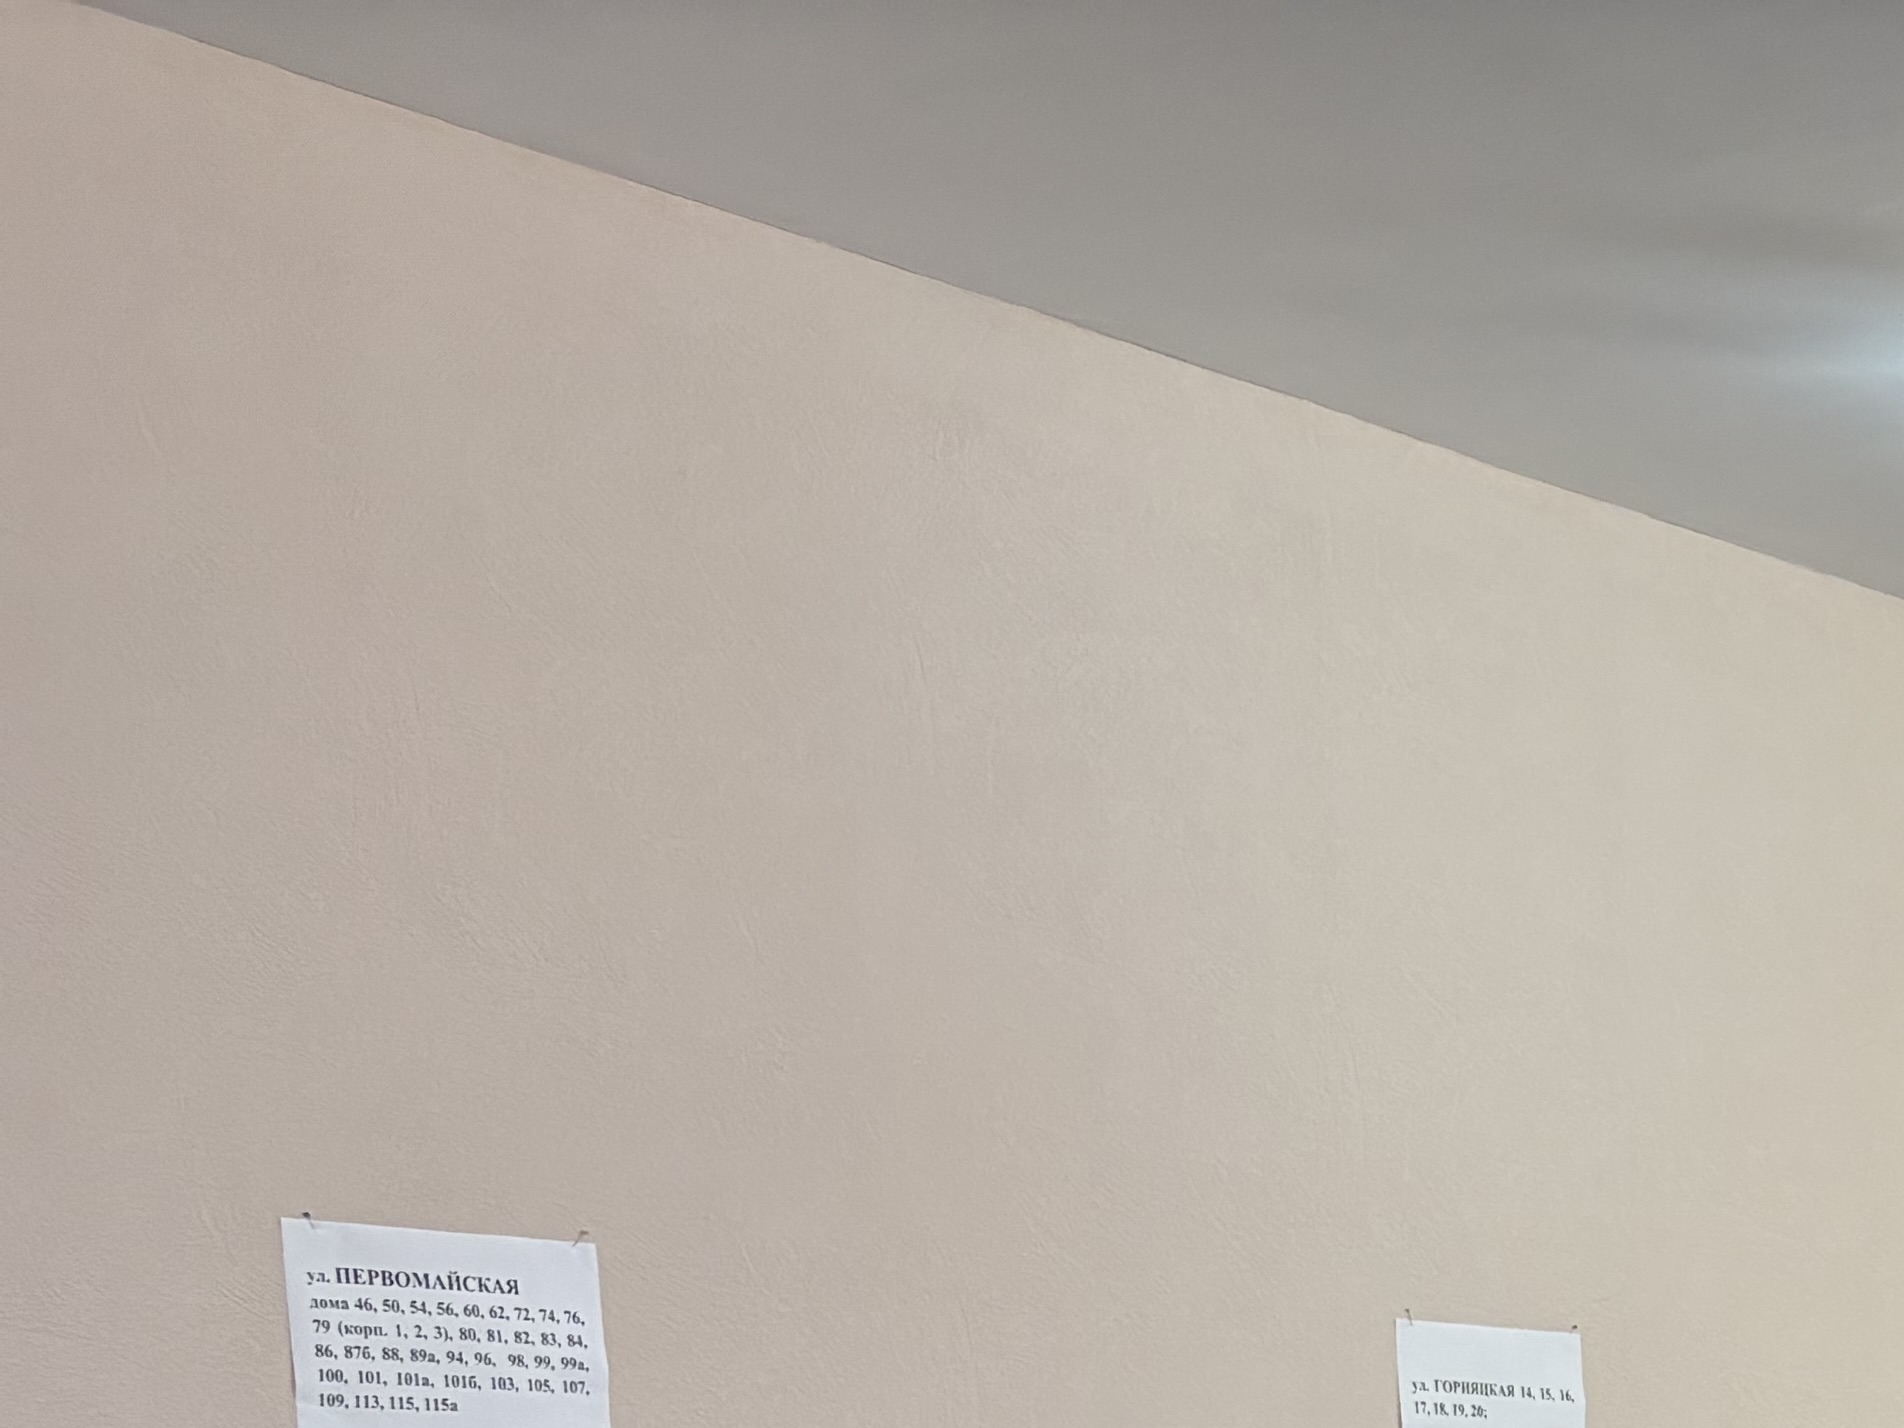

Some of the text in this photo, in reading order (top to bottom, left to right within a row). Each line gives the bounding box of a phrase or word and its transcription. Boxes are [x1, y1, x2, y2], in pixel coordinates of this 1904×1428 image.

[306, 1267, 519, 1295] ул. ПЕРВОМАЙСКАЯ
[310, 1298, 349, 1309] дома
[354, 1298, 377, 1313] 46,
[382, 1299, 405, 1315] 50,
[437, 1302, 458, 1317] 56,
[514, 1308, 535, 1322] 72,
[539, 1309, 560, 1324] 74,
[564, 1311, 585, 1326] 76,
[312, 1319, 330, 1333] 79
[338, 1321, 388, 1339] (корп.
[1411, 1381, 1429, 1394] ул.
[1434, 1379, 1515, 1398] ГОРНЯЦКАЯ
